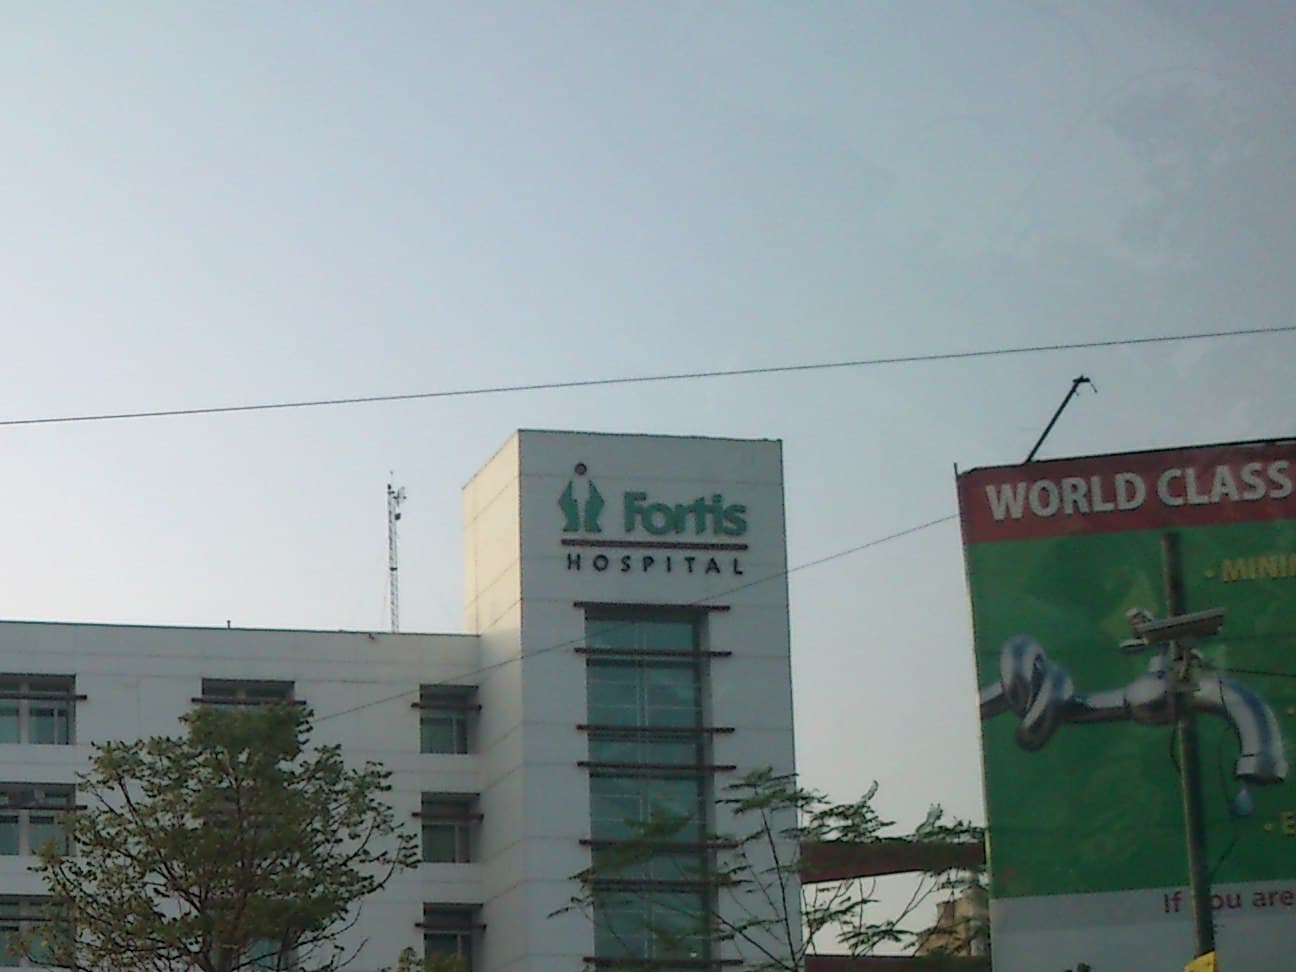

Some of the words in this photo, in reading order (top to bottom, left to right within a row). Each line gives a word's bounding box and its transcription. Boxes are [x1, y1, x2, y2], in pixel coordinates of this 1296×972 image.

[985, 472, 1147, 522] WORLD
[1157, 460, 1294, 507] CLASS
[623, 491, 748, 536] Fortis
[566, 553, 744, 576] HOSPITAL
[1163, 891, 1183, 913] If
[1251, 889, 1296, 908] are
